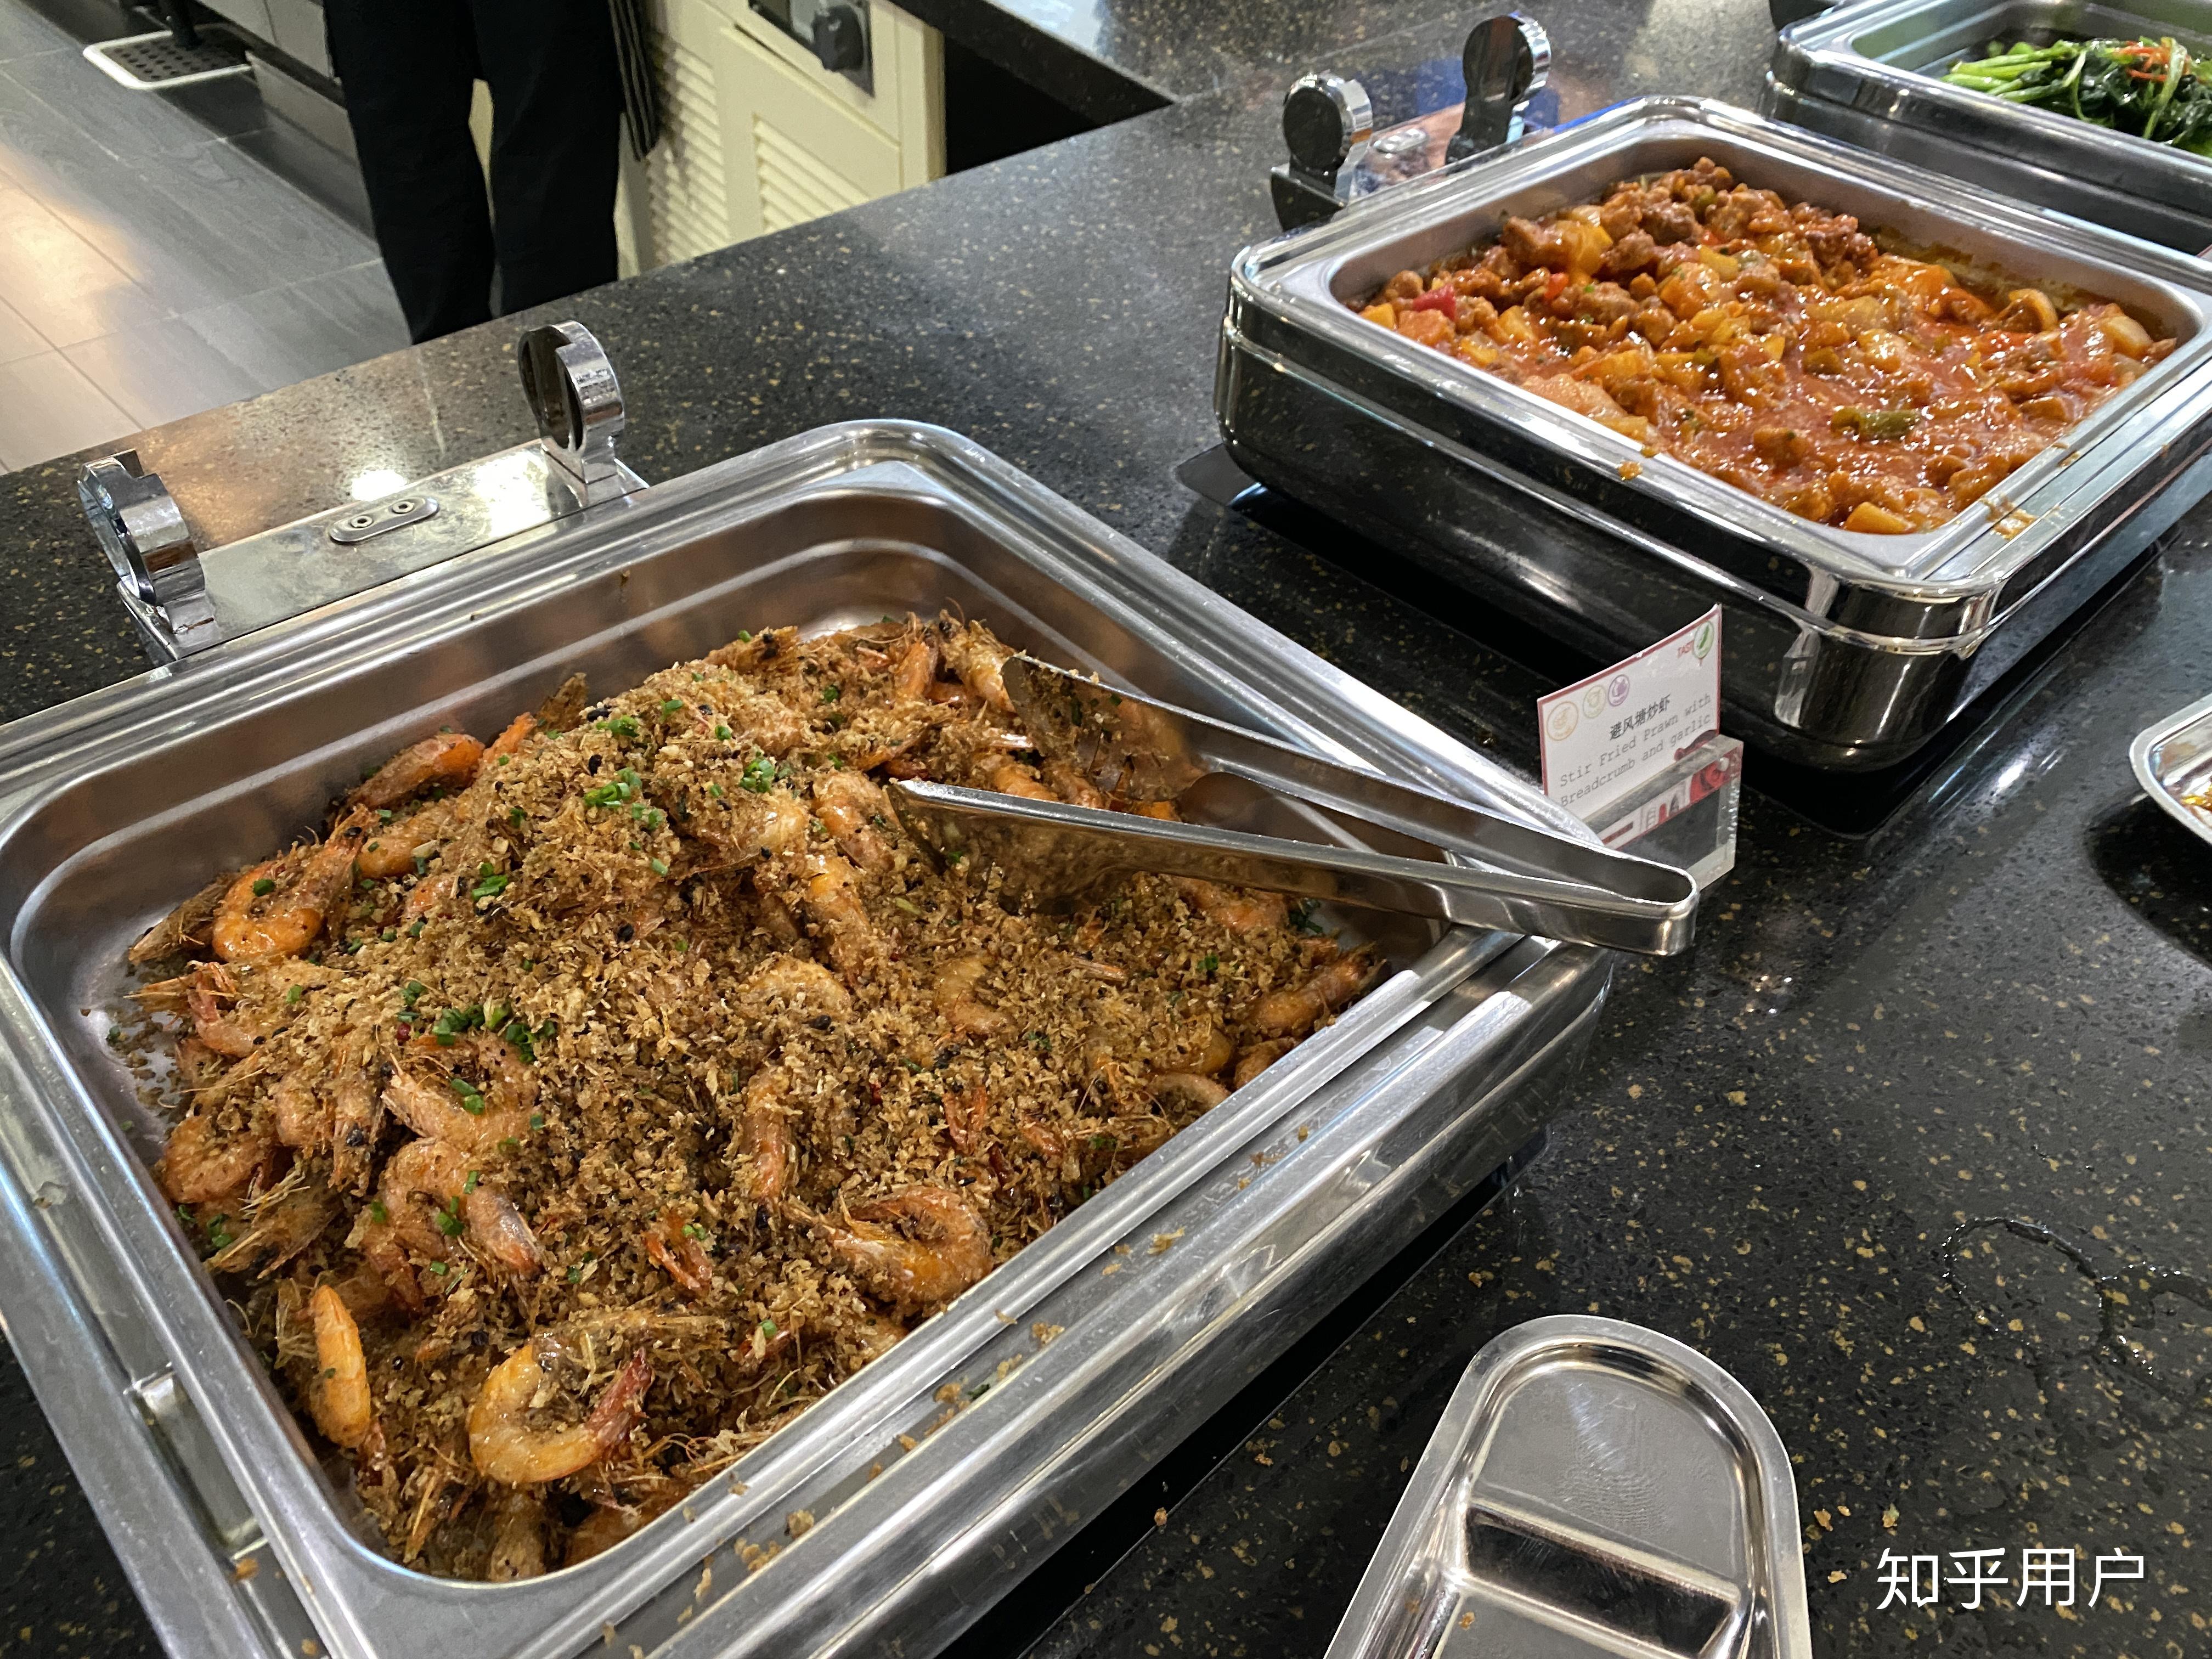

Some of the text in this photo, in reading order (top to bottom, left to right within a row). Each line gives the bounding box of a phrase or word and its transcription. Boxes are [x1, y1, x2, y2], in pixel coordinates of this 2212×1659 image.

[1560, 693, 1711, 787] Stir Fried Prawn with
[1561, 714, 1711, 808] Breadcrumb and garlic
[1610, 693, 1671, 741] 避风塘炒虾
